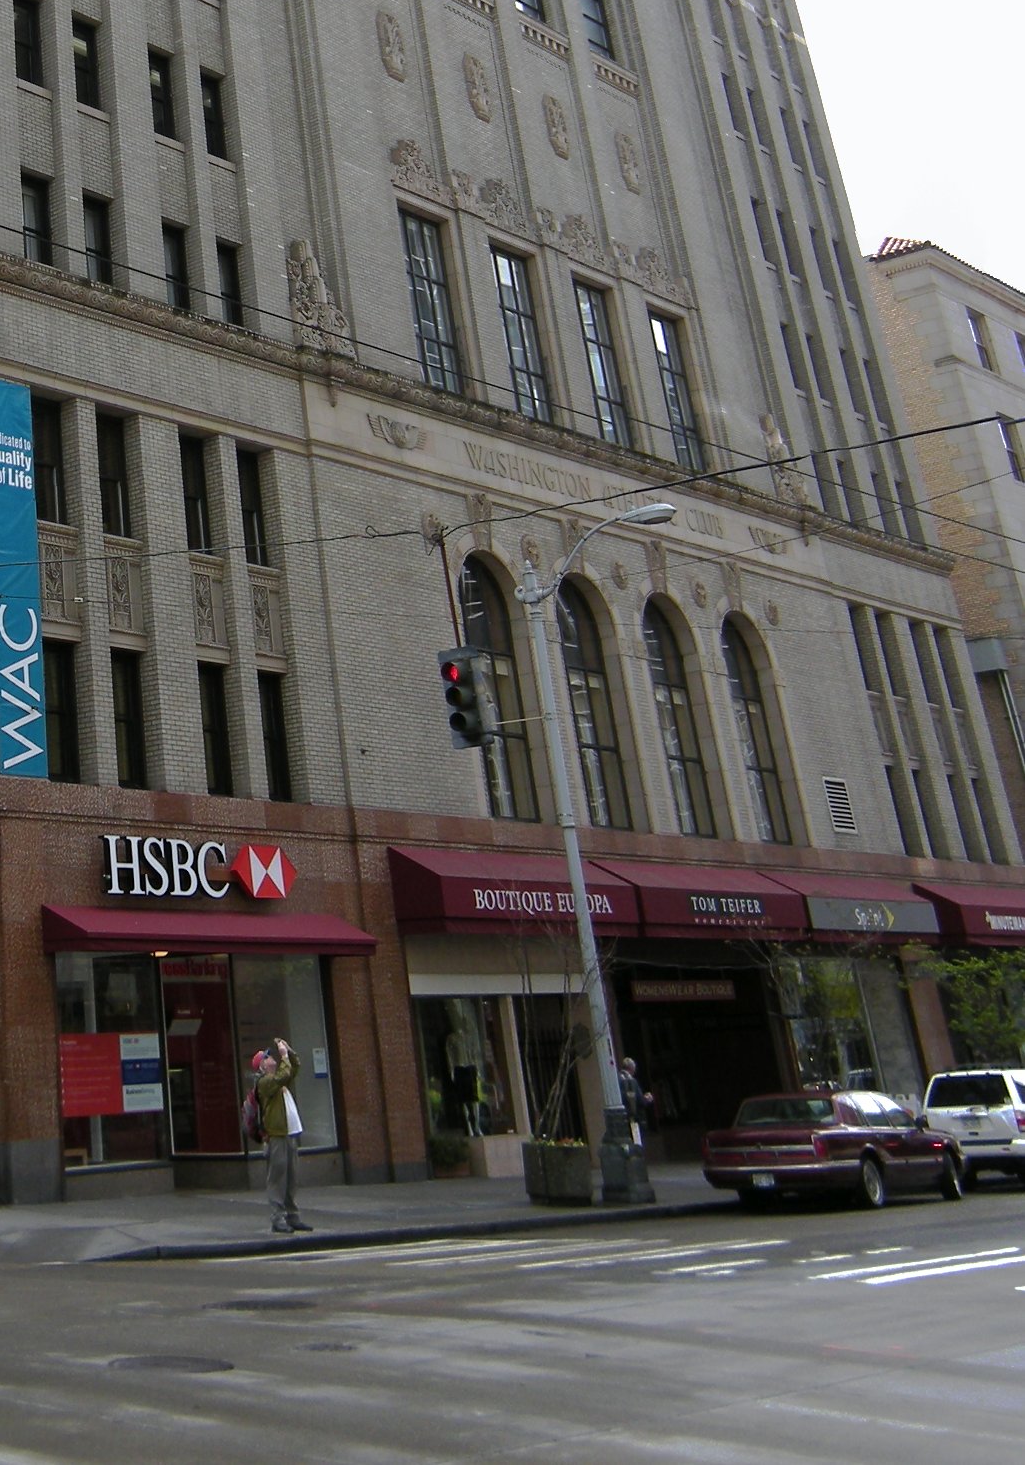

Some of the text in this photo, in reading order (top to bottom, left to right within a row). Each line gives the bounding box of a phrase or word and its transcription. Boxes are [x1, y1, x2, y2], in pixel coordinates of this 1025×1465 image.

[24, 438, 32, 451] to
[8, 467, 33, 490] Life
[462, 440, 591, 500] WASHINGTON
[685, 509, 723, 539] CLUB
[103, 835, 230, 899] HSBC
[473, 889, 613, 916] BOUTIQUE EUOPA
[690, 896, 762, 914] TOM TEIFER
